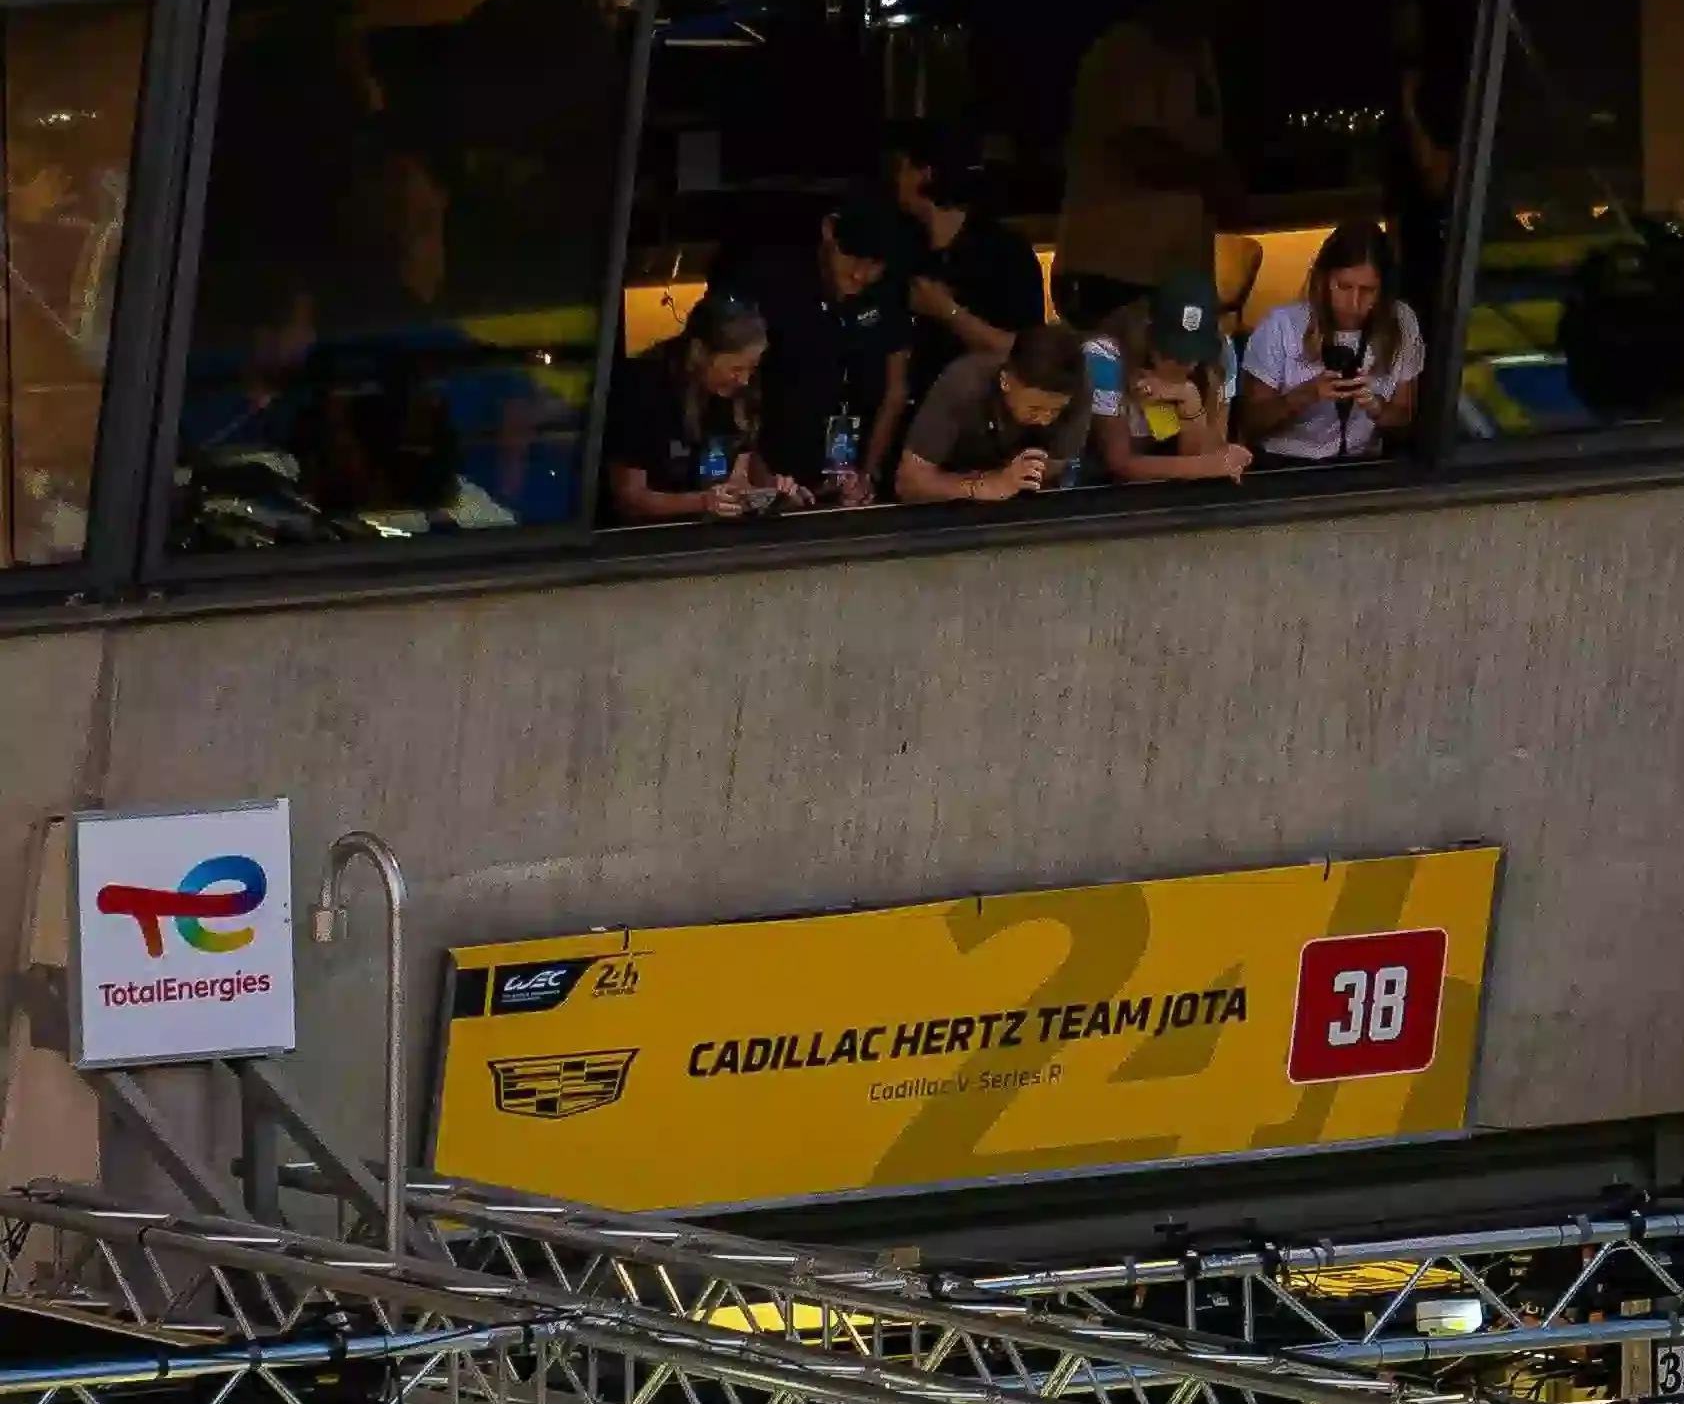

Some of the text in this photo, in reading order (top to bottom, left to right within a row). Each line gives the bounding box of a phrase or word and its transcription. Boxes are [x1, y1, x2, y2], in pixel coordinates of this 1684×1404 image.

[100, 969, 271, 1009] TotalEnergies
[503, 969, 568, 992] WEC
[1328, 965, 1408, 1046] 38
[686, 986, 1248, 1078] CADILLAC HERTZ TEAM JOTA
[868, 1076, 951, 1102] Cadillac
[1050, 1066, 1063, 1086] R
